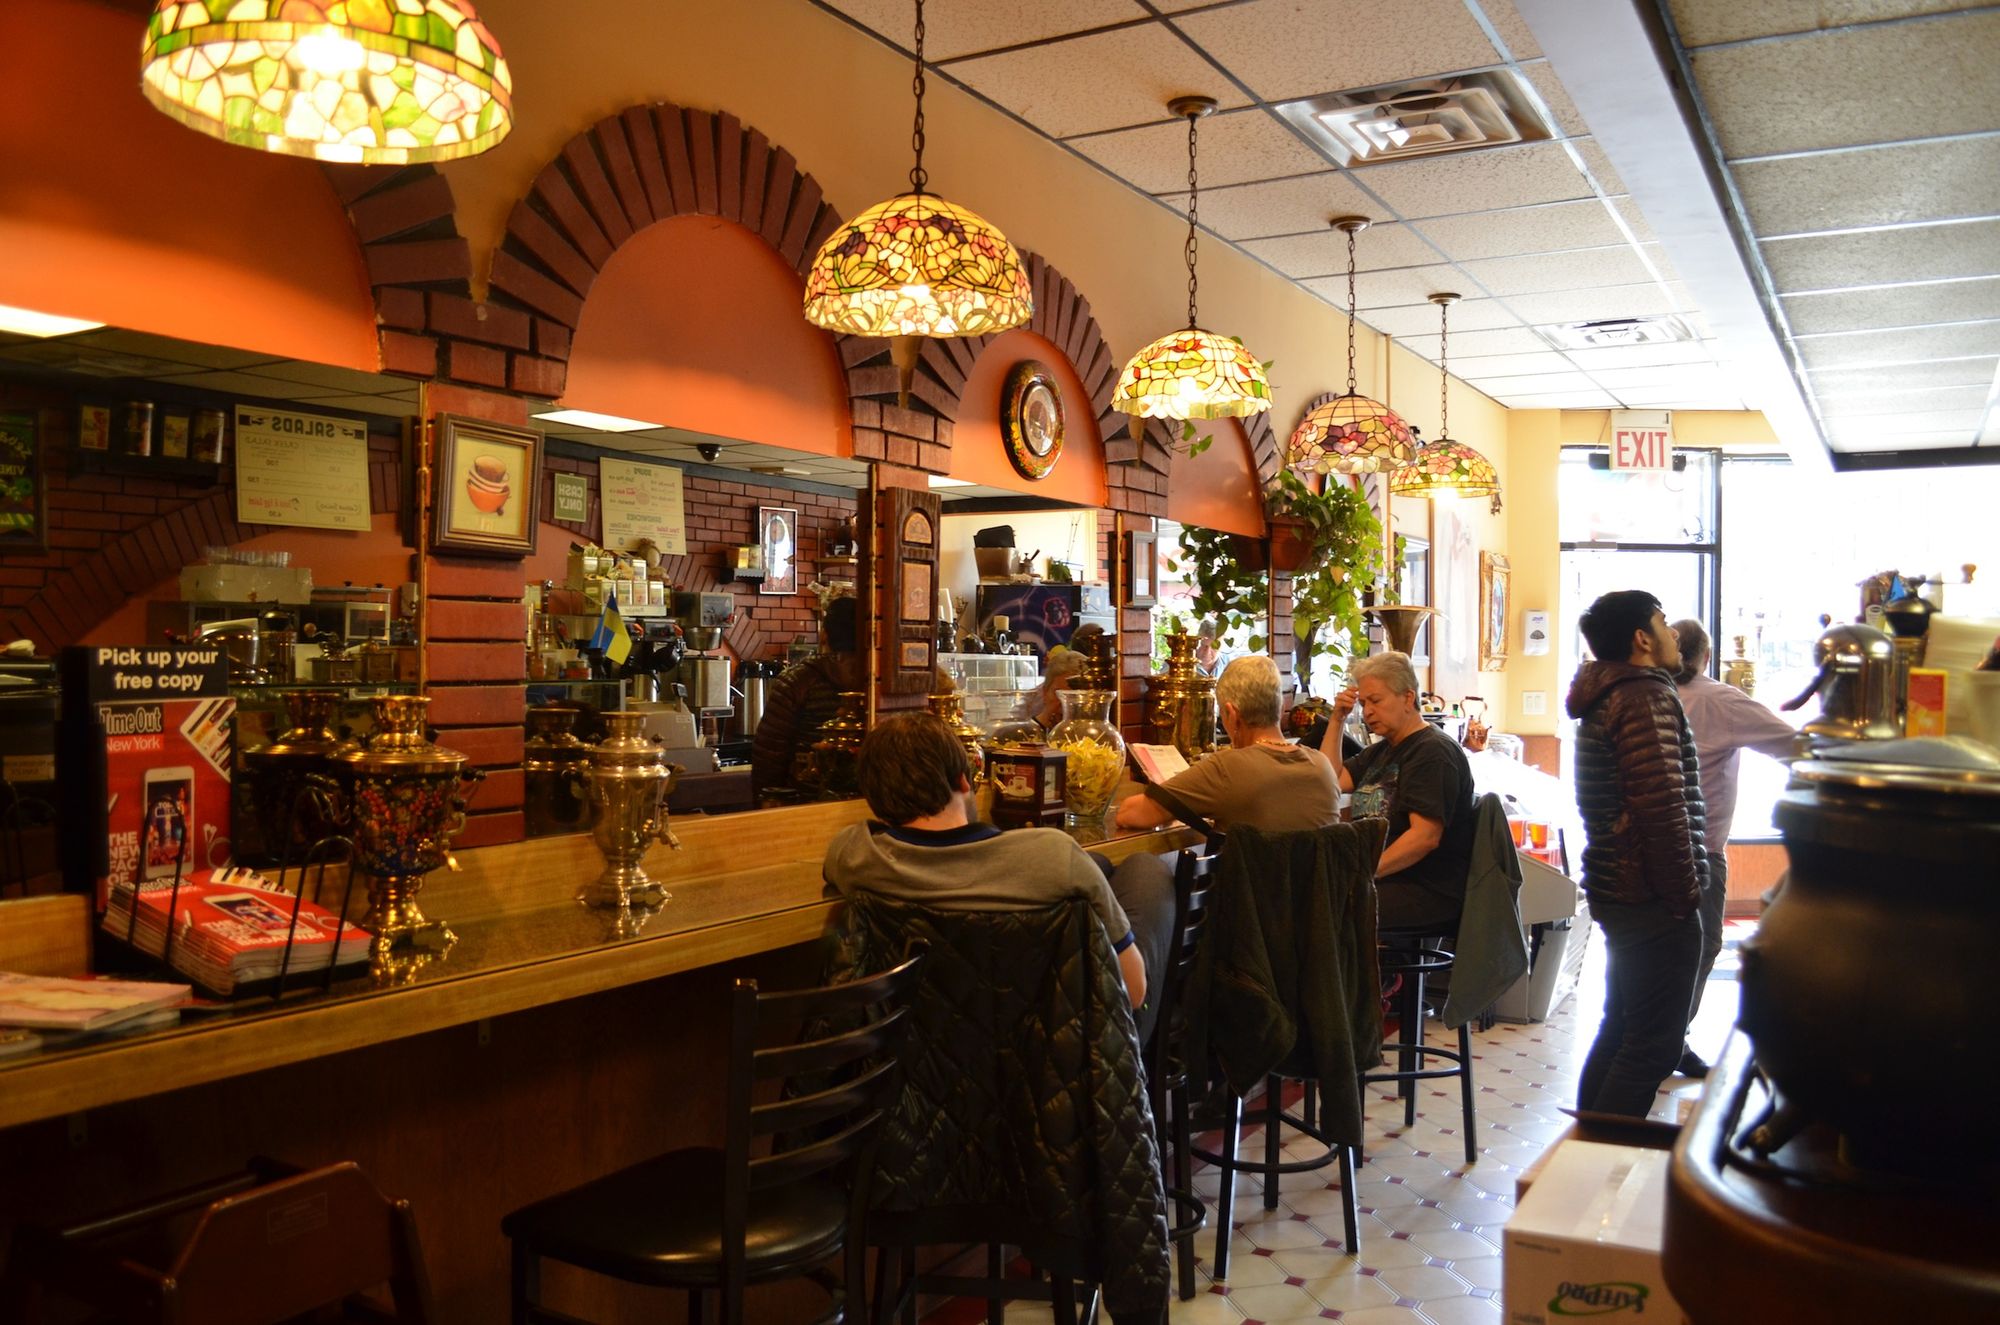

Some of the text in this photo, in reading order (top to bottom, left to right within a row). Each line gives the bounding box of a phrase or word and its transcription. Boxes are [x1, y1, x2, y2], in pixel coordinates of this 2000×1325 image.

[1616, 431, 1668, 468] EXIT
[97, 648, 219, 669] Pick up your
[114, 672, 204, 691] free copy
[99, 706, 162, 735] Time Out
[133, 735, 161, 750] York
[108, 831, 138, 846] THE
[109, 845, 141, 859] NEW
